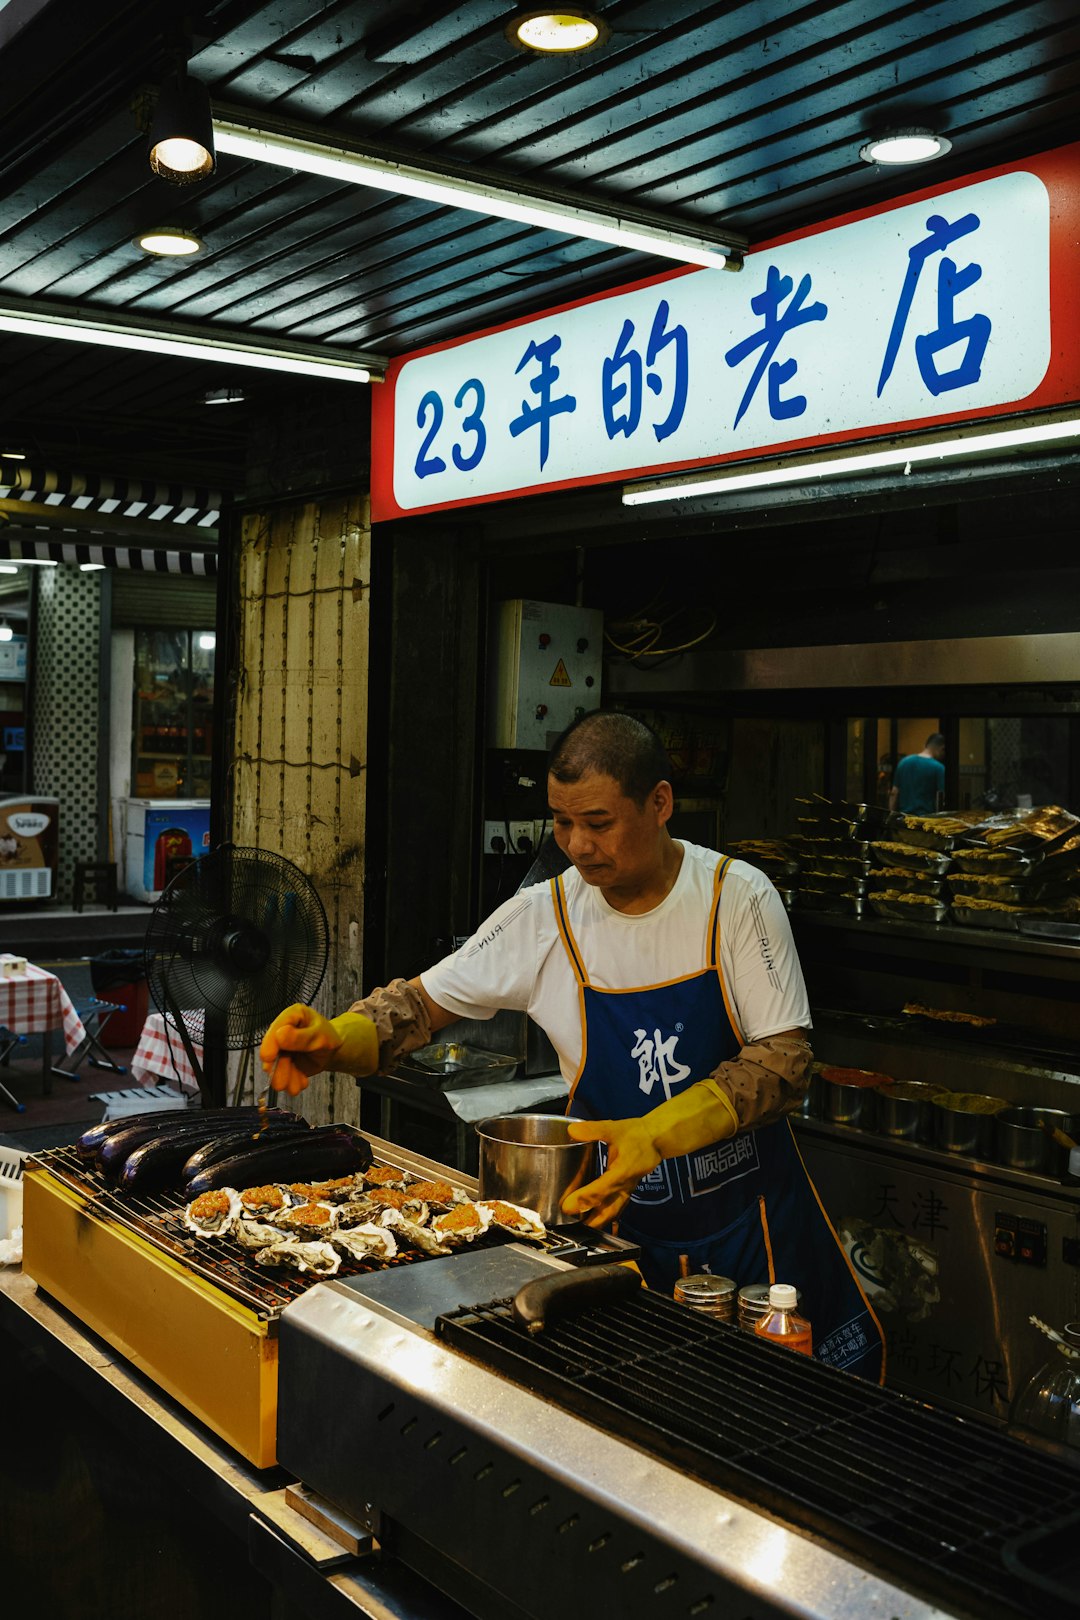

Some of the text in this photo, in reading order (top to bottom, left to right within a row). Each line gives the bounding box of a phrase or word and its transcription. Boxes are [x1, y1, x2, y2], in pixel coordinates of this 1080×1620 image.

[413, 213, 992, 480] 23年的老店
[758, 938, 776, 971] RUN
[694, 1135, 753, 1181] 顺品郎
[872, 1184, 949, 1242] 天津
